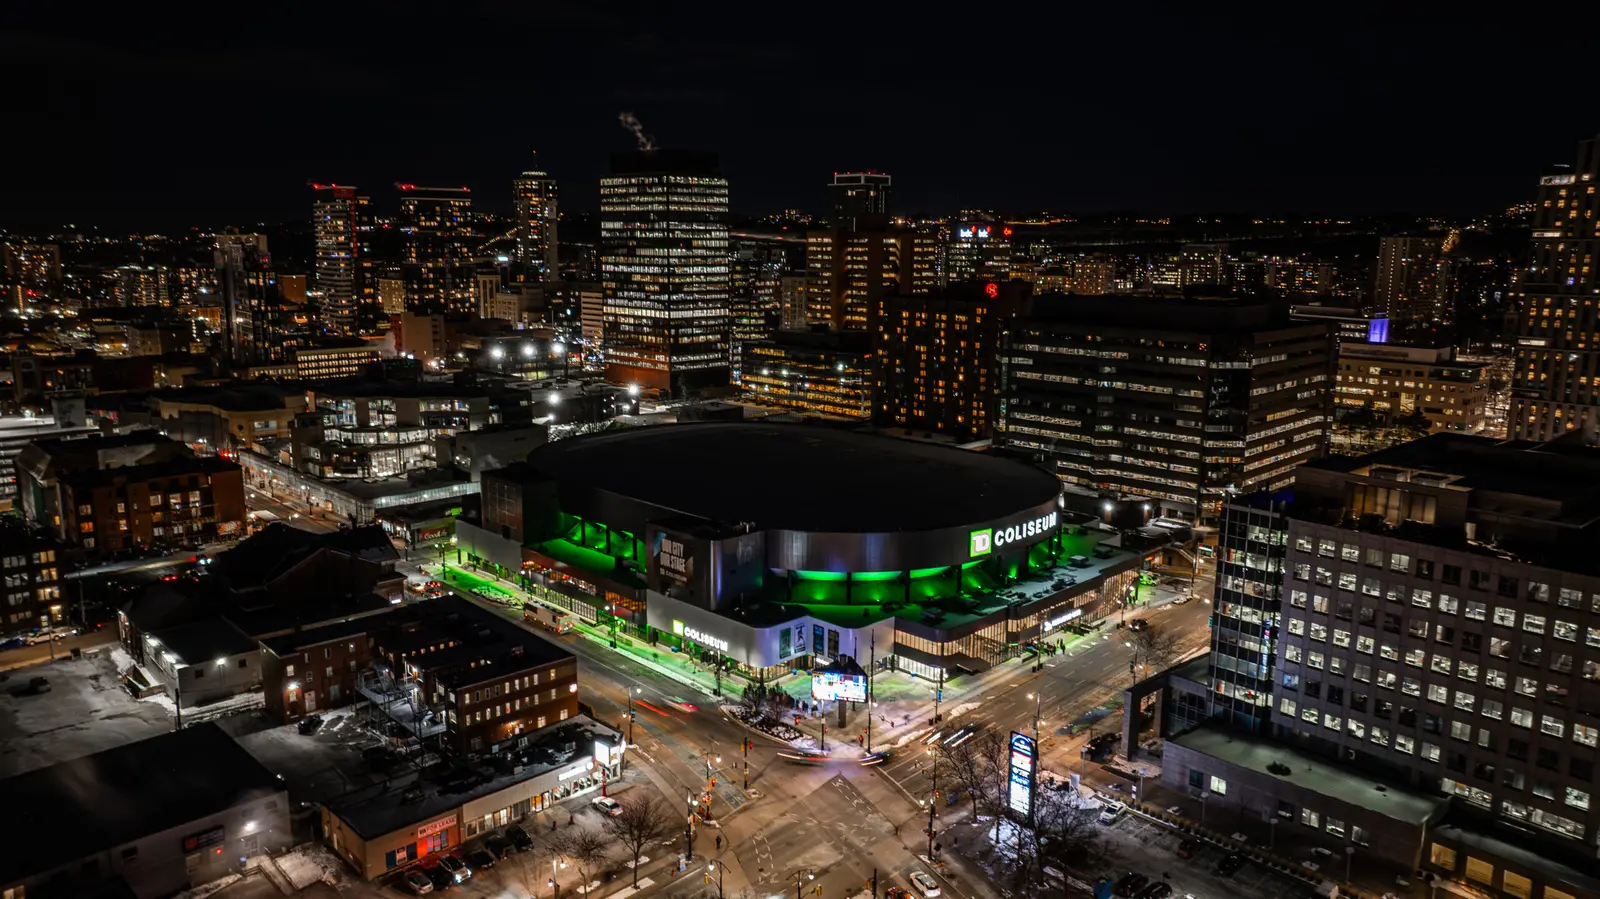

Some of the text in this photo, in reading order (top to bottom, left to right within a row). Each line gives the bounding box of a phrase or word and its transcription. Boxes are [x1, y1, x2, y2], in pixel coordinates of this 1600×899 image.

[994, 512, 1057, 546] COLISEUM
[672, 541, 684, 557] CITY
[684, 626, 728, 652] COLISEUM
